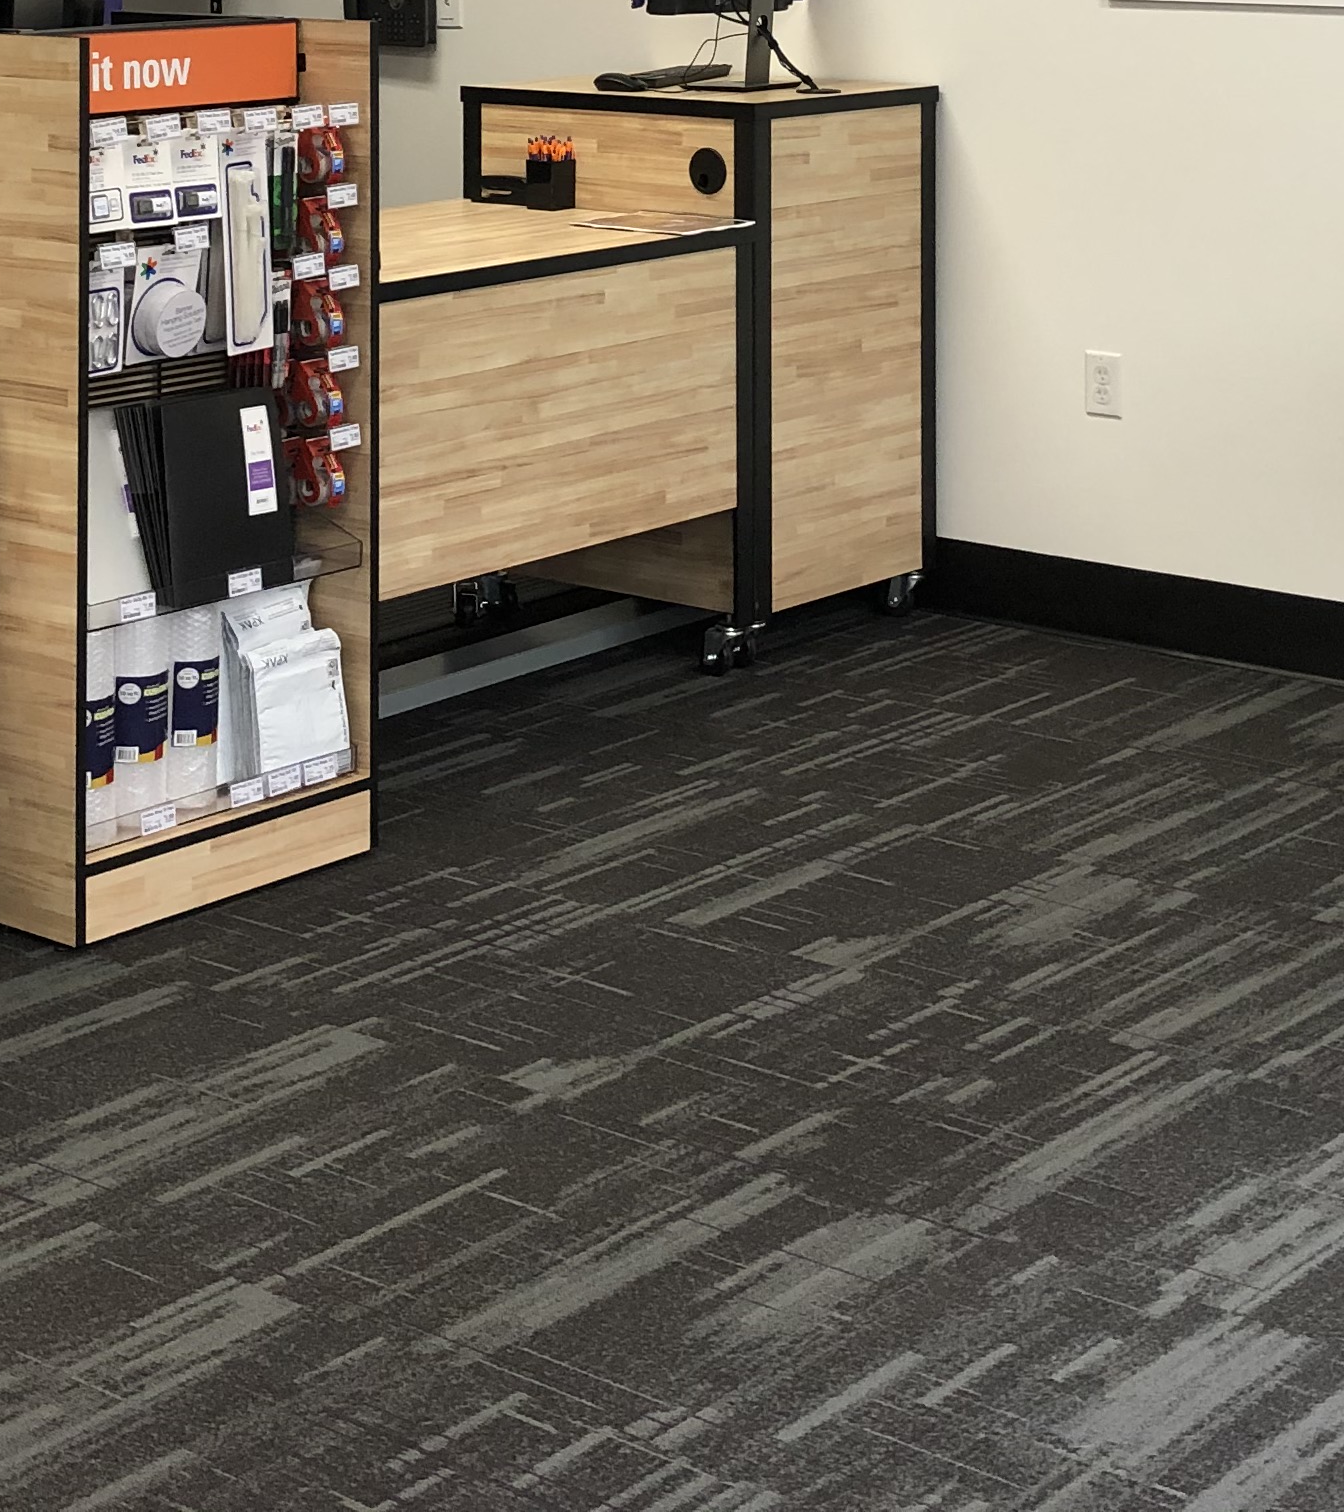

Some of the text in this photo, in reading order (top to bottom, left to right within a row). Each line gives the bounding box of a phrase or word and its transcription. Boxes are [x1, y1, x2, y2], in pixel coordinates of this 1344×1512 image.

[91, 51, 191, 92] it now
[133, 153, 158, 165] FedEx
[180, 148, 205, 160] FedEx
